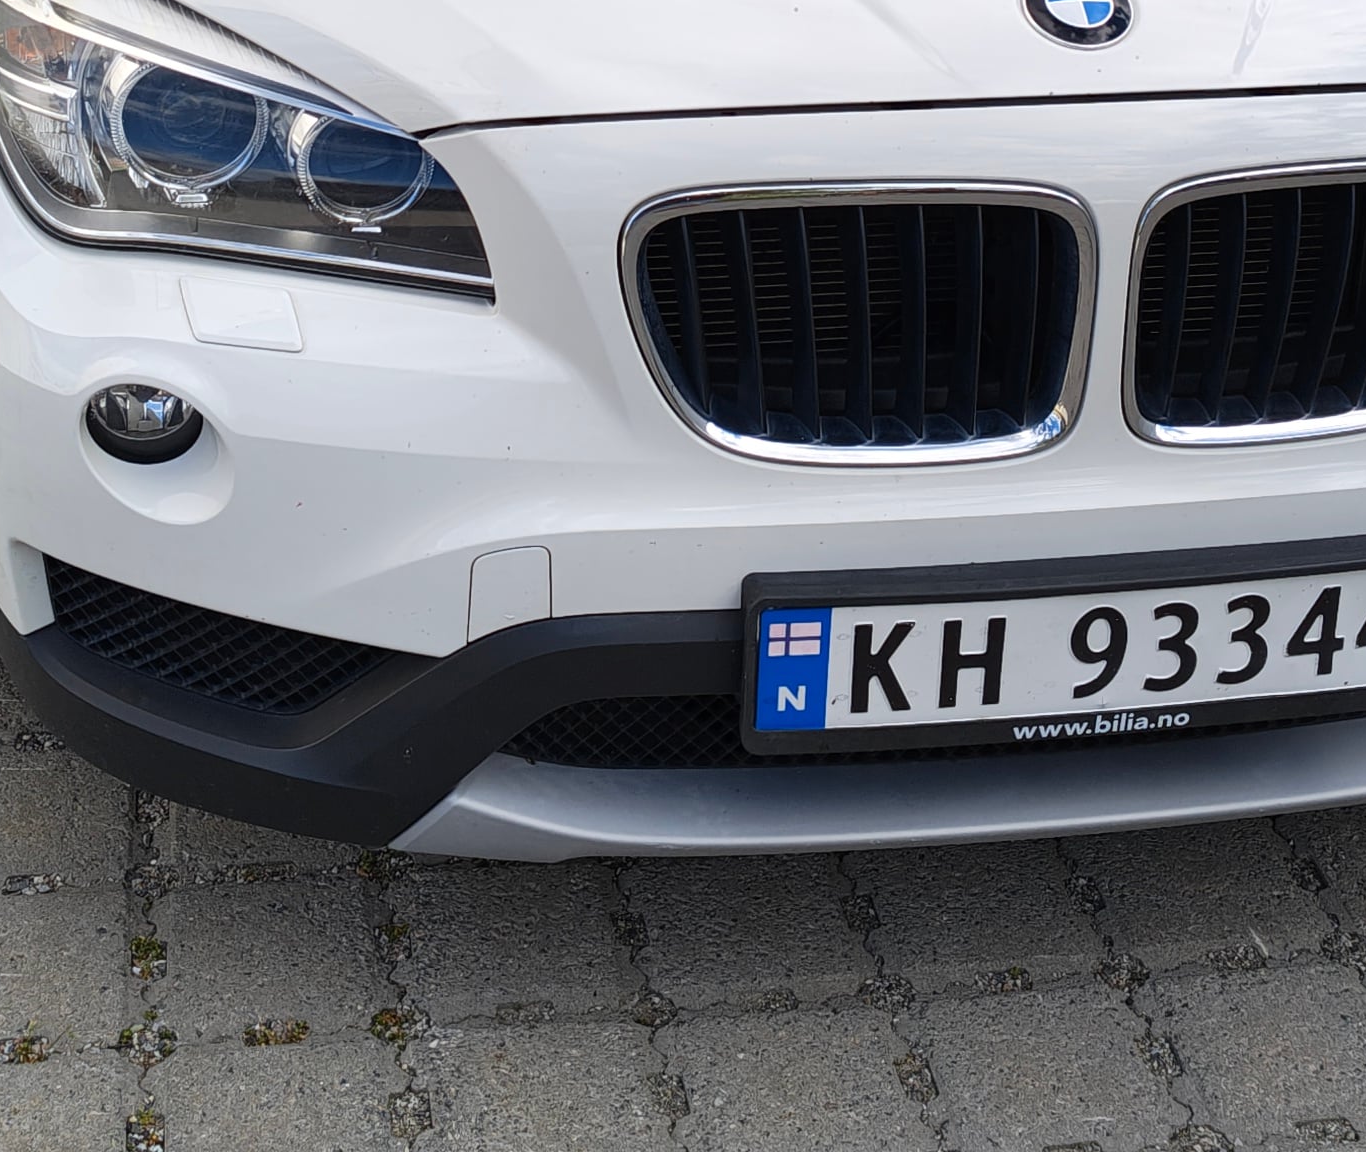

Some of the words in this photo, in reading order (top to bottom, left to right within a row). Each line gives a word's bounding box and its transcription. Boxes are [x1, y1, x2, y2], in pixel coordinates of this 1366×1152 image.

[850, 617, 1007, 713] KH
[777, 685, 806, 712] N
[1013, 712, 1190, 740] www.bilia.no
